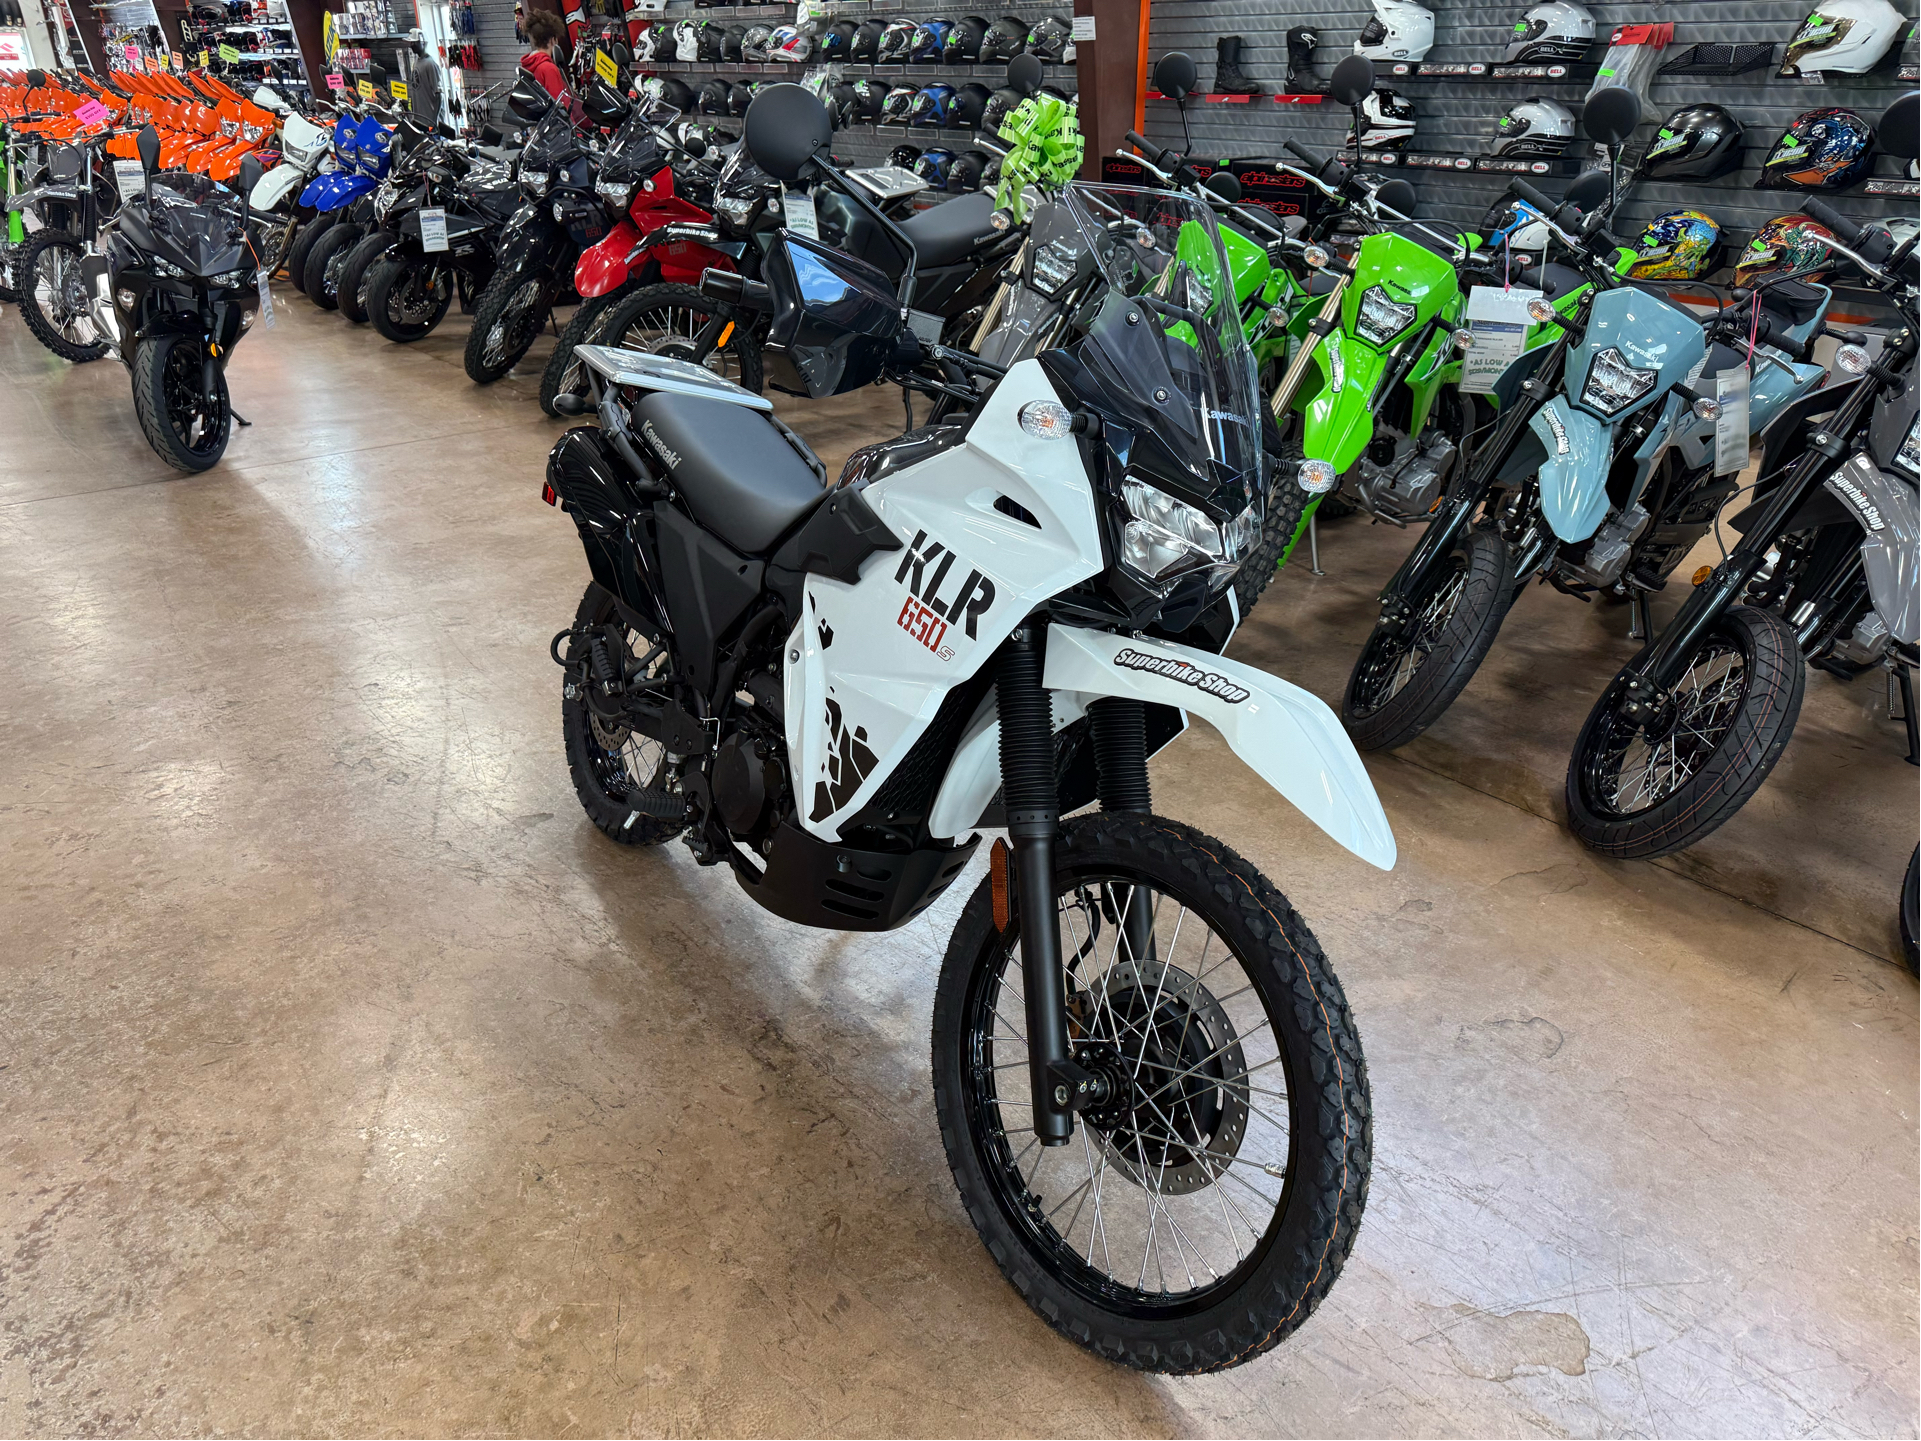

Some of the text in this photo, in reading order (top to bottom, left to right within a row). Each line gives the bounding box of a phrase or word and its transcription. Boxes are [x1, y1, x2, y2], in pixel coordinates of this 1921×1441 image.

[1106, 163, 1142, 174] alpinestars
[1240, 172, 1306, 187] alpinestars
[585, 226, 603, 238] 650
[666, 227, 700, 236] Superbike
[668, 242, 688, 256] 650
[1625, 340, 1660, 362] Kawasaki
[1200, 407, 1251, 429] Kawasaki
[641, 419, 682, 470] Kawasaki
[1829, 471, 1886, 531] Superbike Shop
[893, 528, 996, 642] KLR
[1114, 649, 1249, 702] Superbike Shop
